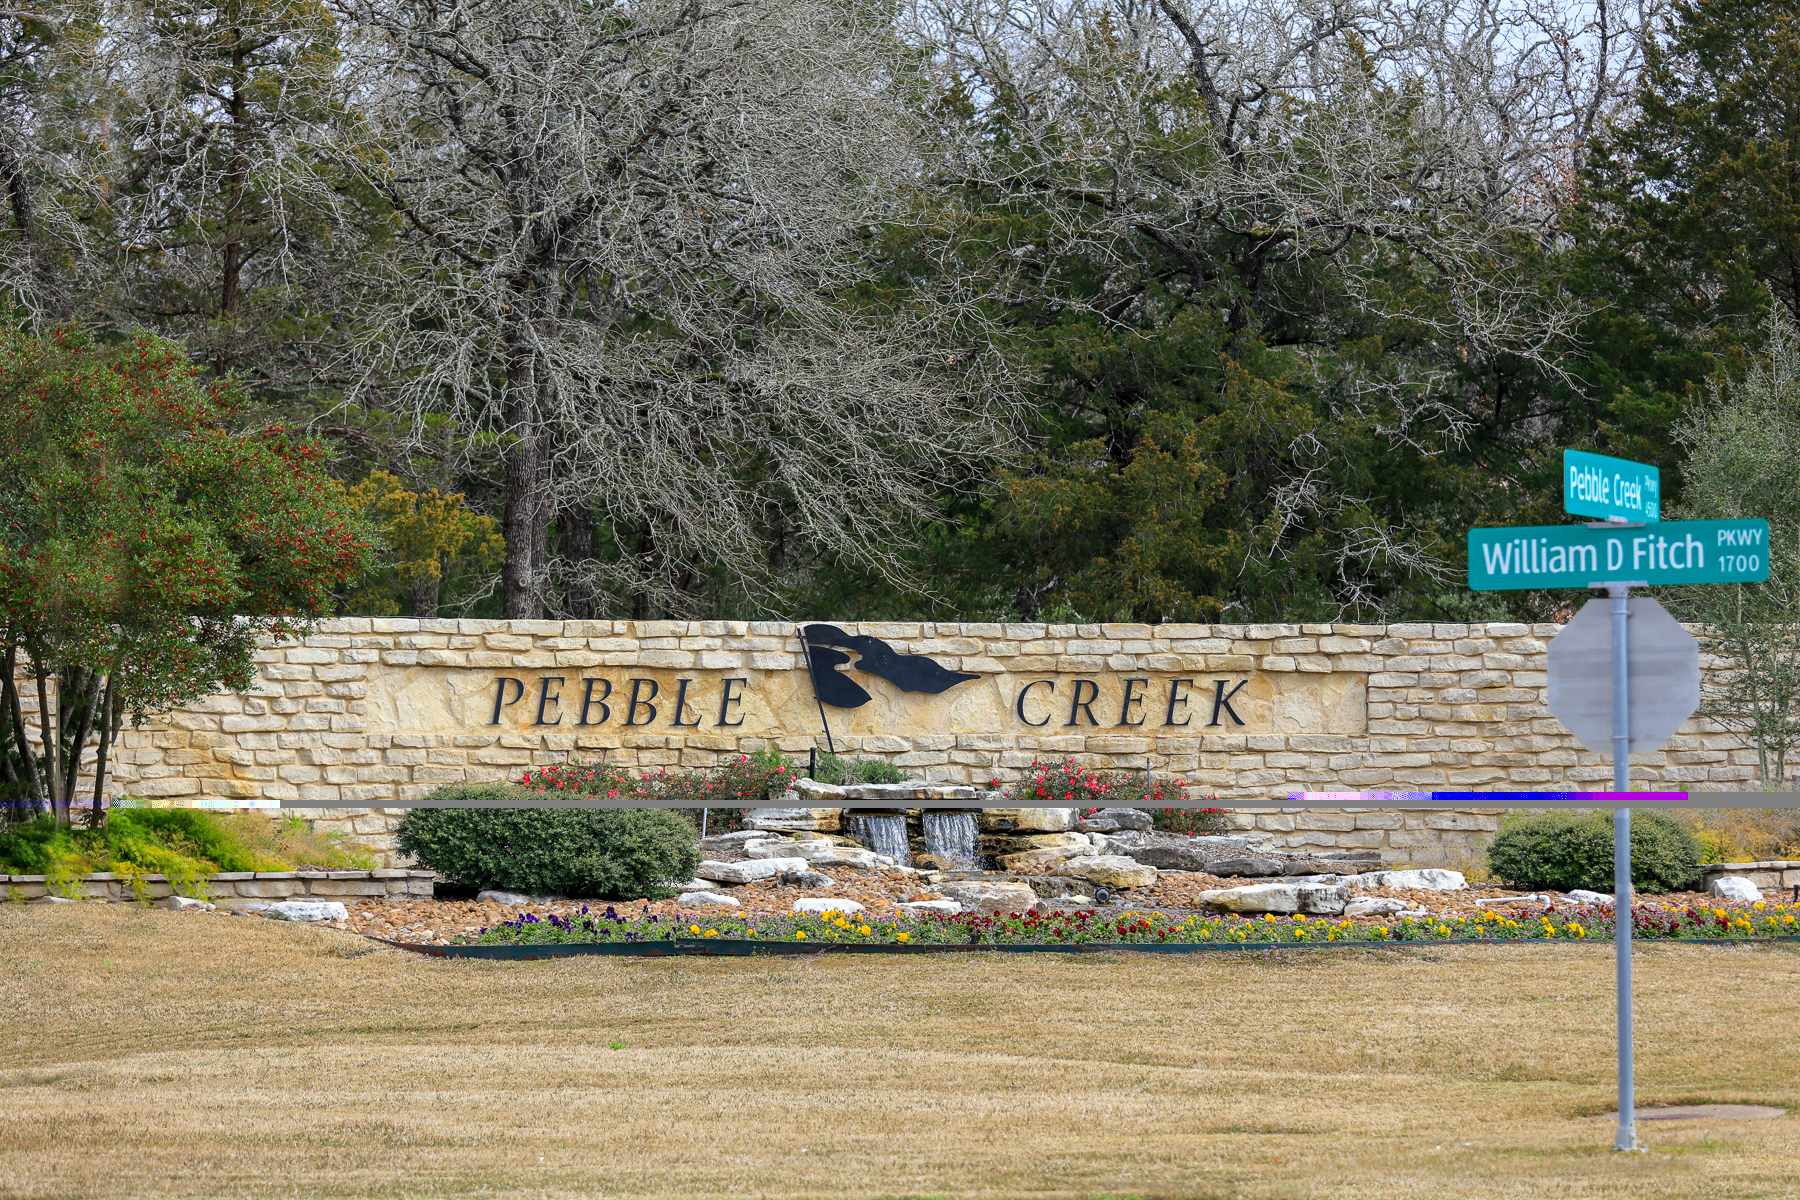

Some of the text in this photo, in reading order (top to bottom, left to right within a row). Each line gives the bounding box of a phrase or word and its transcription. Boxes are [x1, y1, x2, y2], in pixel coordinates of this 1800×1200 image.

[1570, 465, 1642, 511] Pebble Creek
[1482, 533, 1704, 575] William D Fitch
[1717, 528, 1762, 547] PKWY
[1718, 554, 1760, 573] 1700
[486, 676, 1249, 727] PEBBLE CREEK
